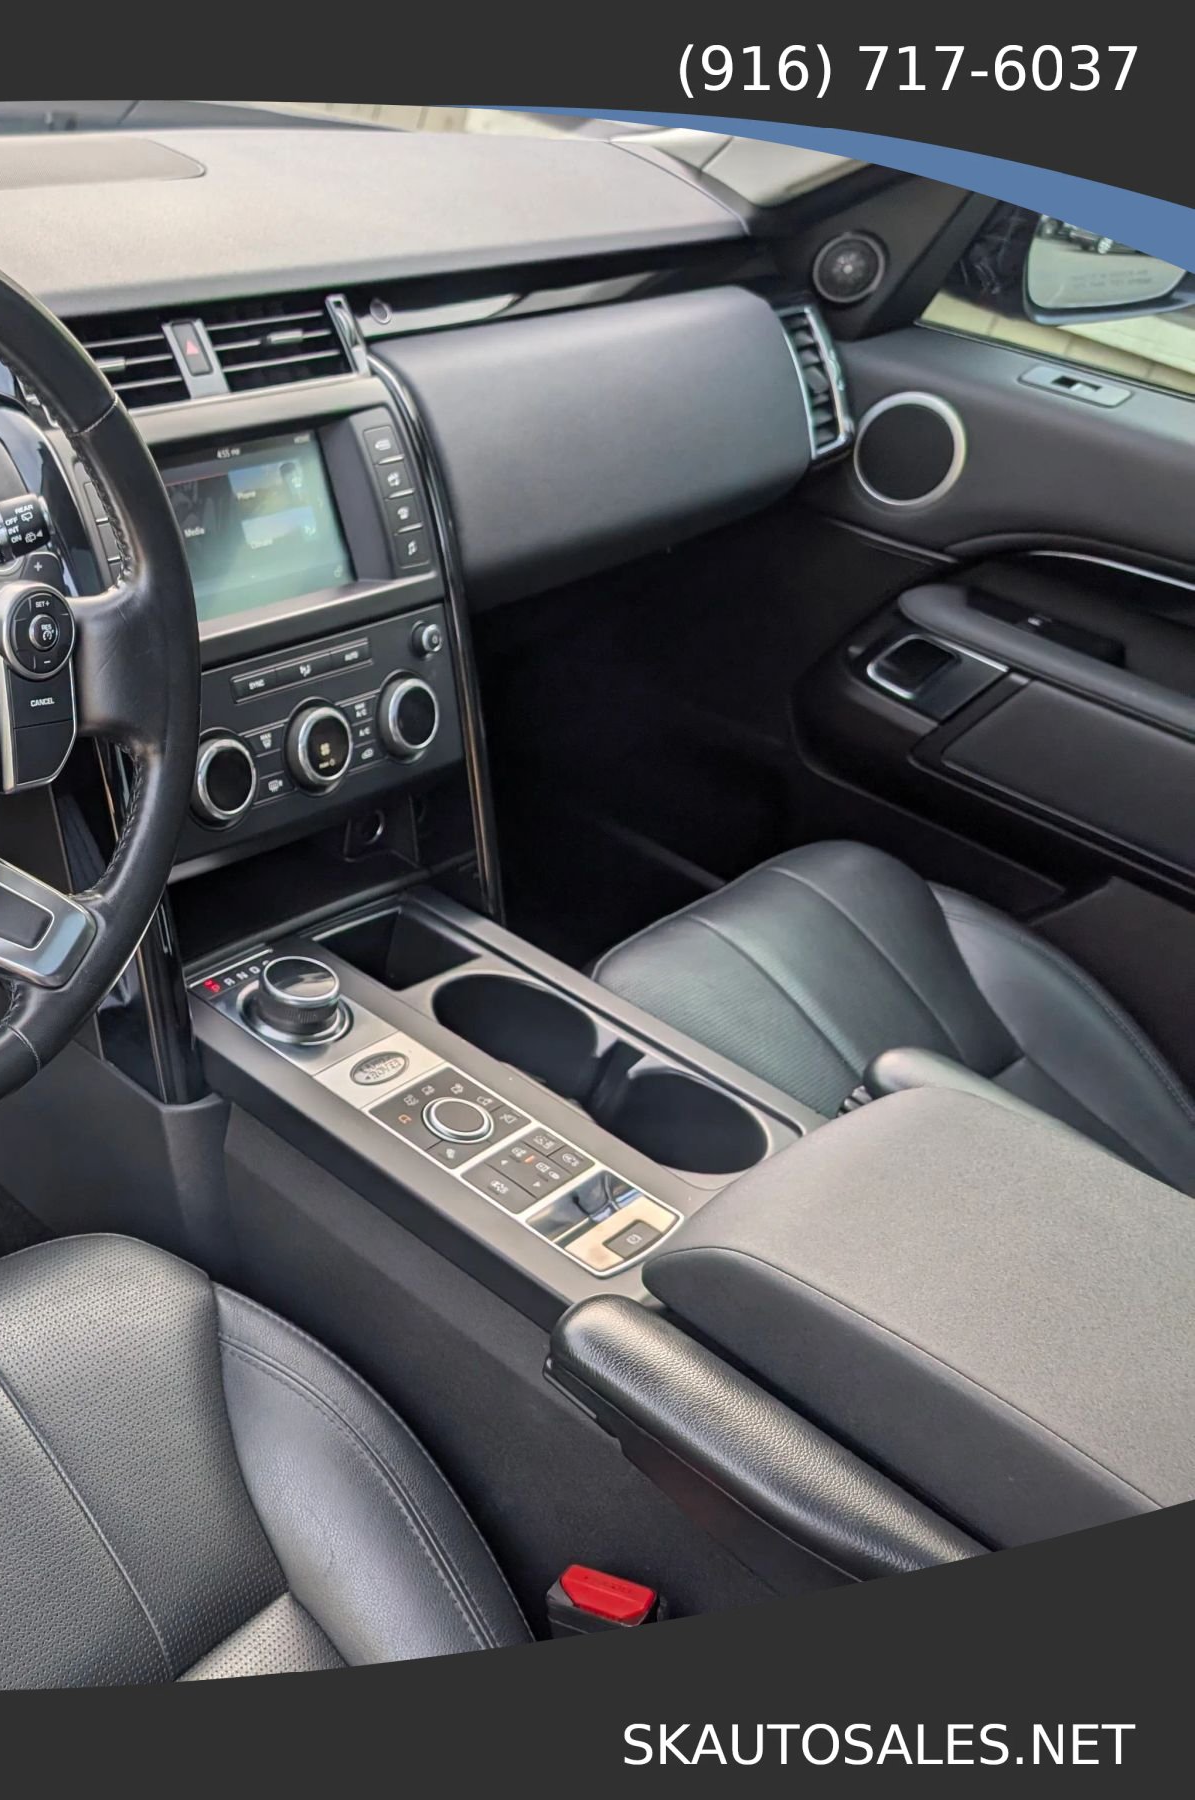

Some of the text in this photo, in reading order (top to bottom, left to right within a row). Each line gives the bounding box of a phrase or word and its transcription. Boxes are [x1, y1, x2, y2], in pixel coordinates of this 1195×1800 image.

[15, 504, 34, 515] REAR
[5, 516, 19, 527] OFF
[7, 525, 20, 536] INT
[30, 696, 55, 708] CANCEL
